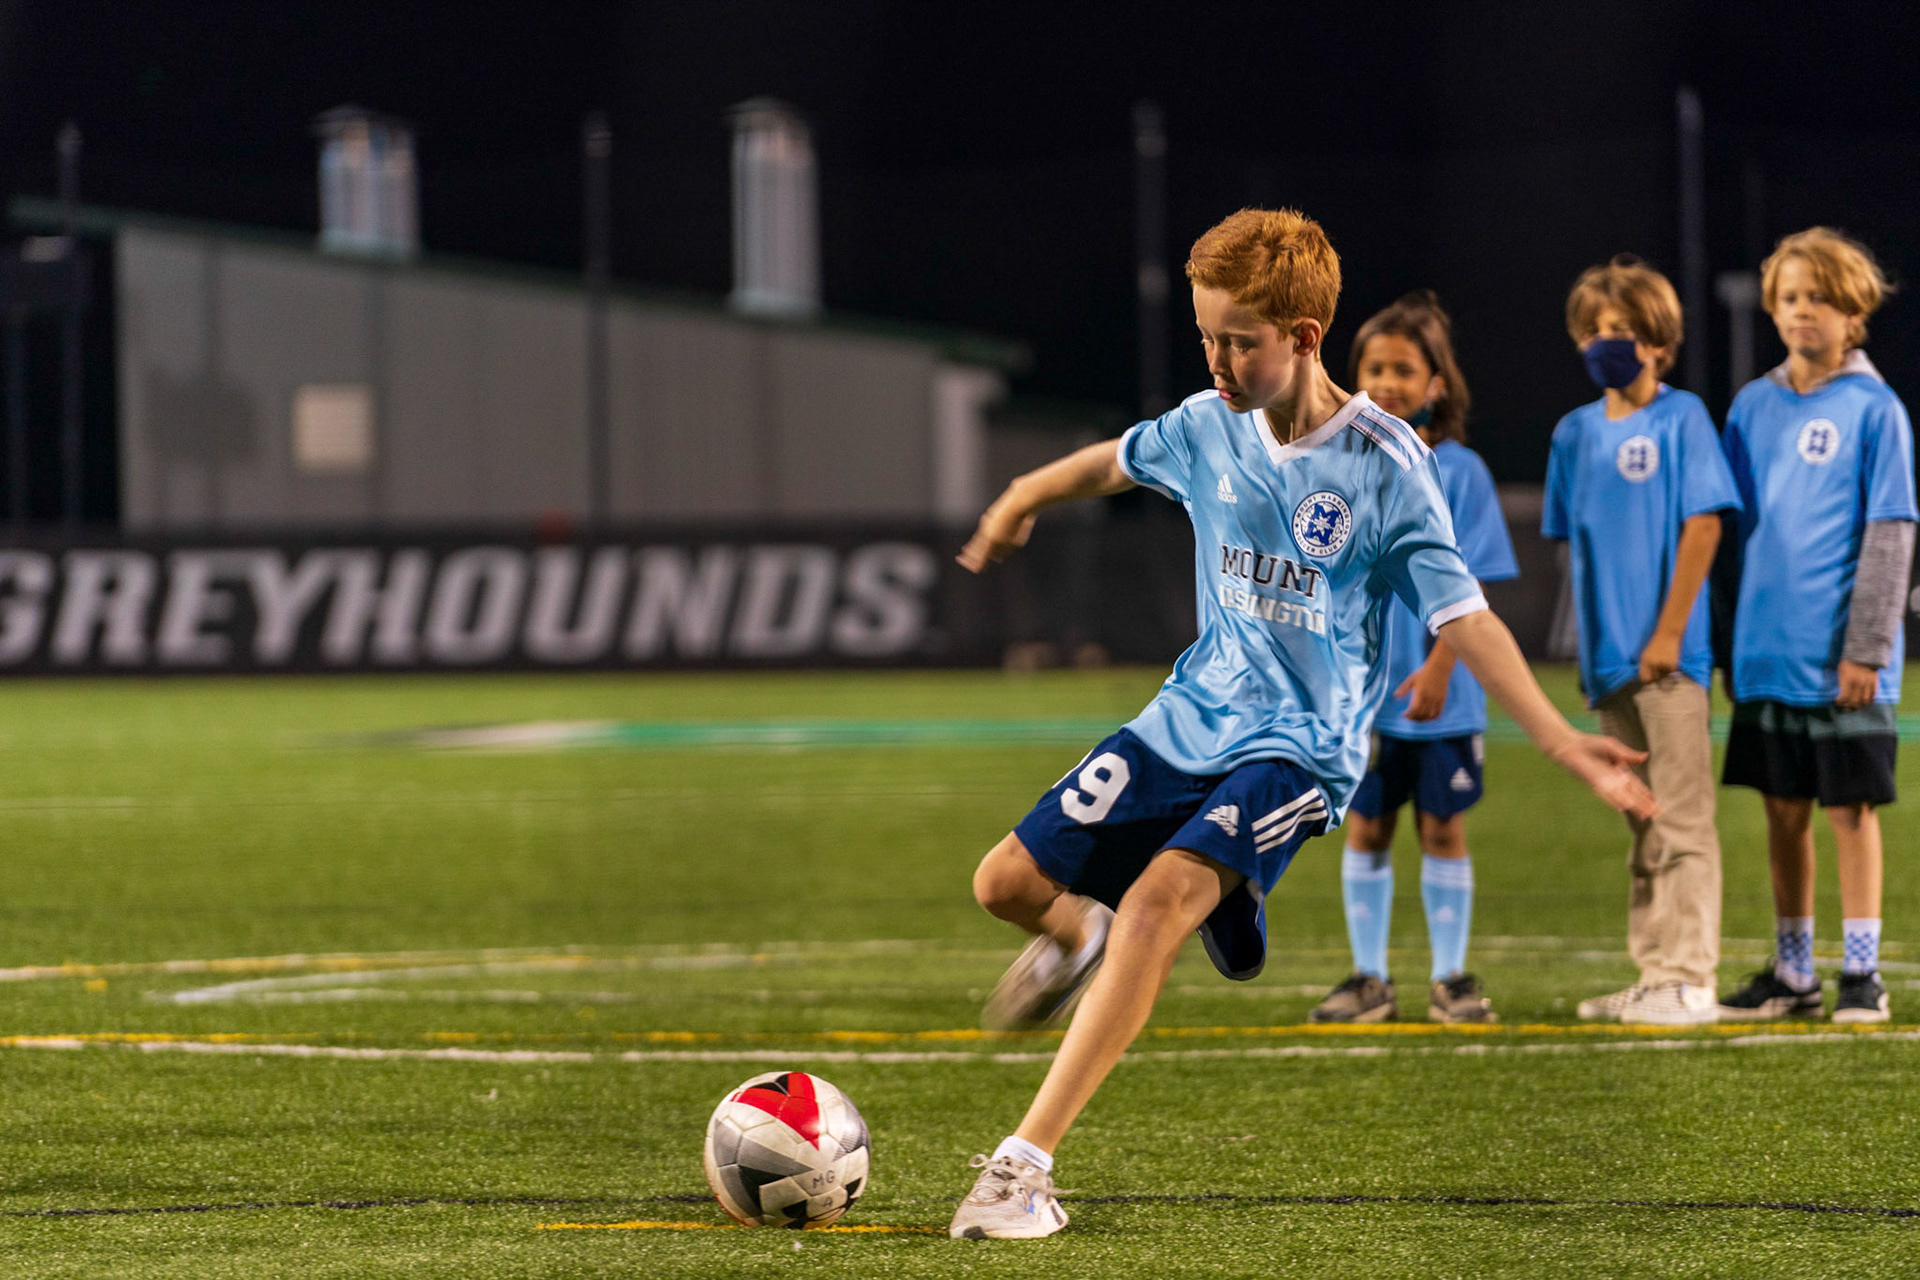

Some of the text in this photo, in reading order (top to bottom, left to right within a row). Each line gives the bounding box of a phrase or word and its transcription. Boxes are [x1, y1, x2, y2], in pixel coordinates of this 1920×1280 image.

[1296, 495, 1350, 535] MOUNT WASHINGTON
[1319, 545, 1338, 554] CLUB
[1220, 544, 1322, 599] MOUNT
